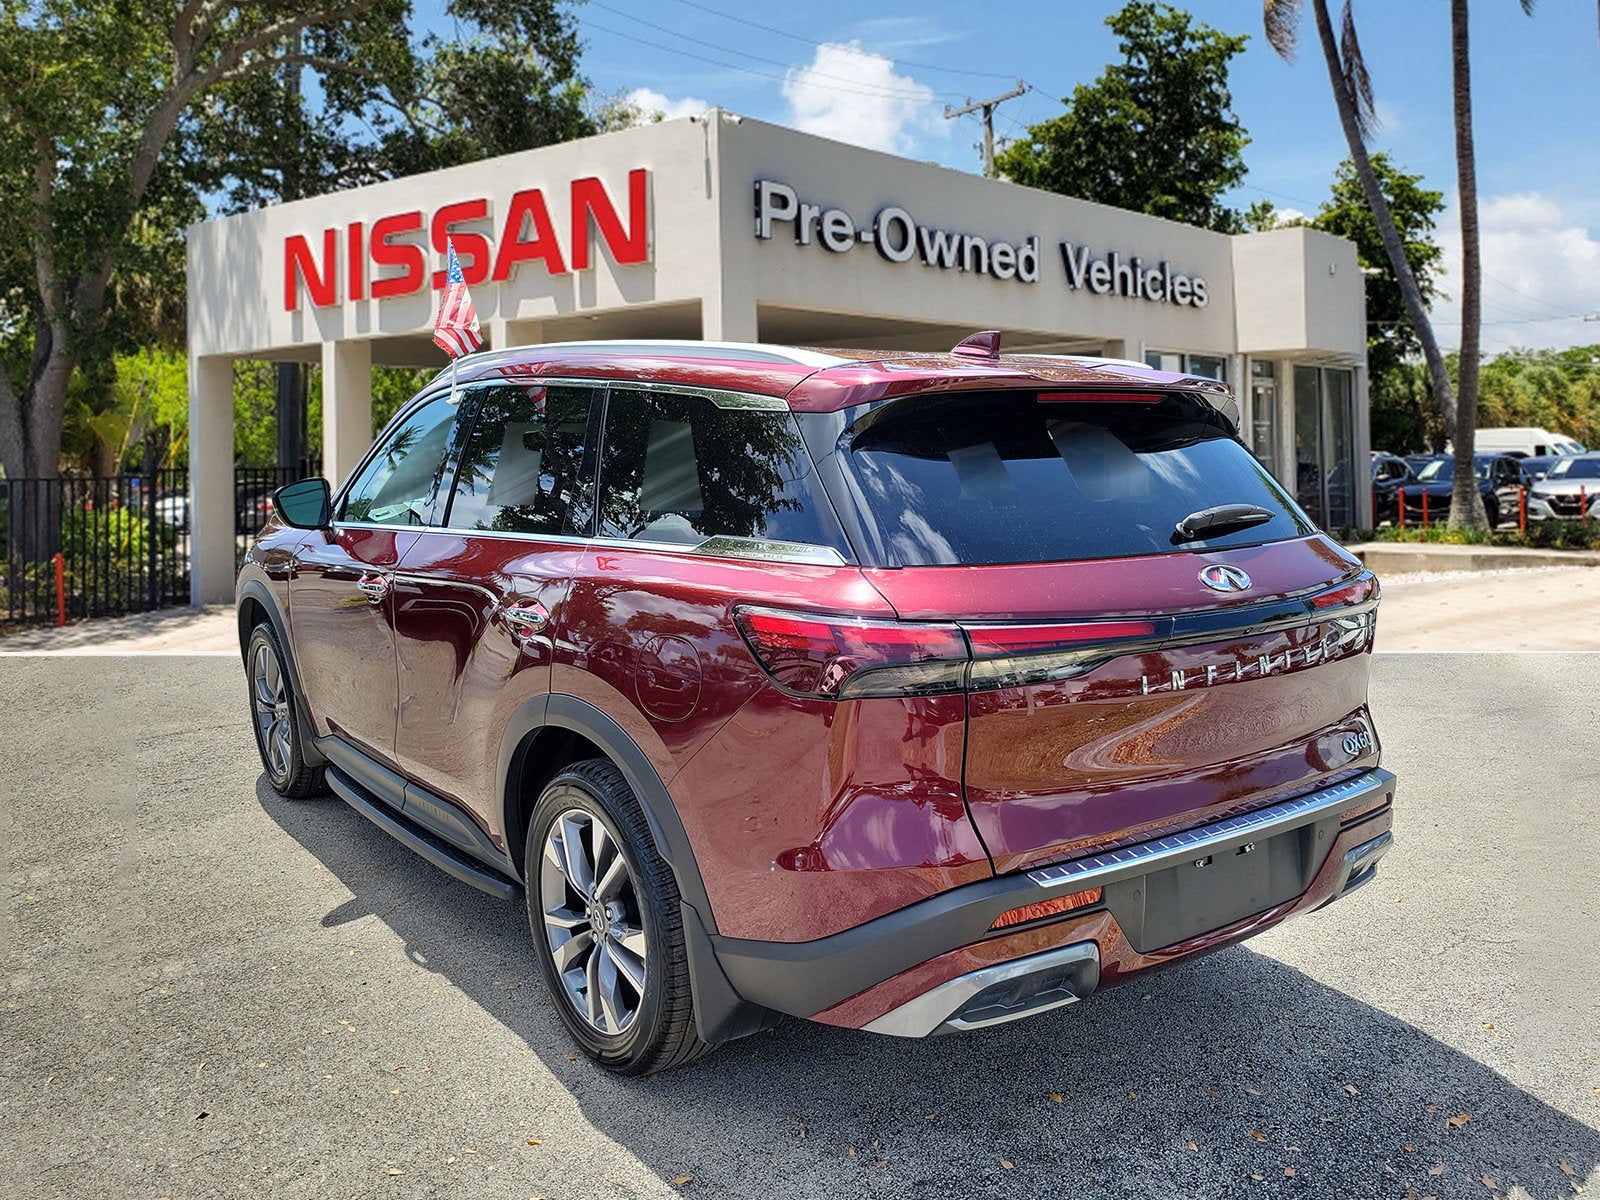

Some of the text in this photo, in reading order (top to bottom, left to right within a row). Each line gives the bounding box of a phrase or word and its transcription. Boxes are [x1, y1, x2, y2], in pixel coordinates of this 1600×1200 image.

[285, 169, 648, 312] NISSAN
[755, 180, 1208, 309] Pre-Owned Vehicles
